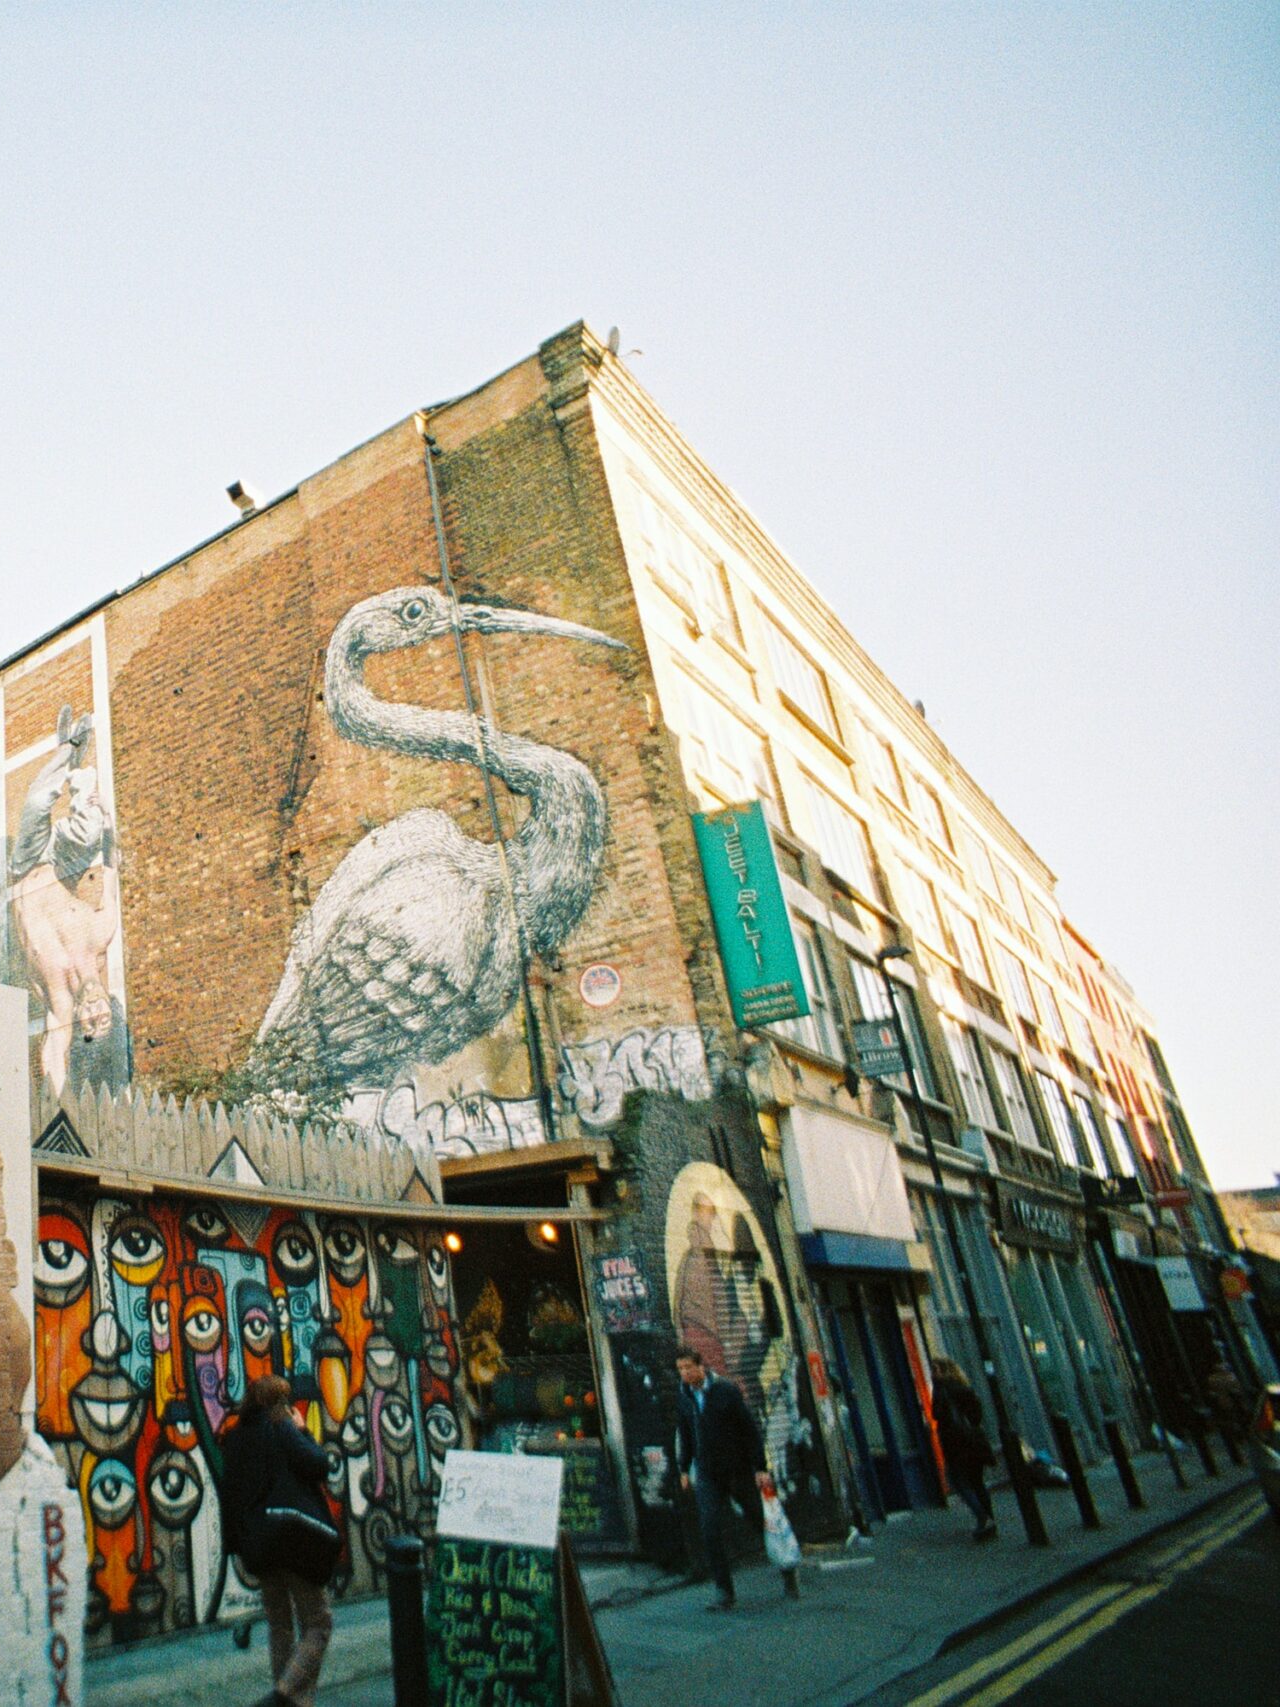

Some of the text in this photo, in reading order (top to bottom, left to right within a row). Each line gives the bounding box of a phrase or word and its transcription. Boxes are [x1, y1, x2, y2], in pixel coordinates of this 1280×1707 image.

[736, 889, 762, 970] BALTI
[600, 1275, 648, 1300] JUICES
[440, 1542, 554, 1596] Jerk Chicken
[444, 1585, 473, 1609] Rice
[447, 1640, 496, 1677] Curry
